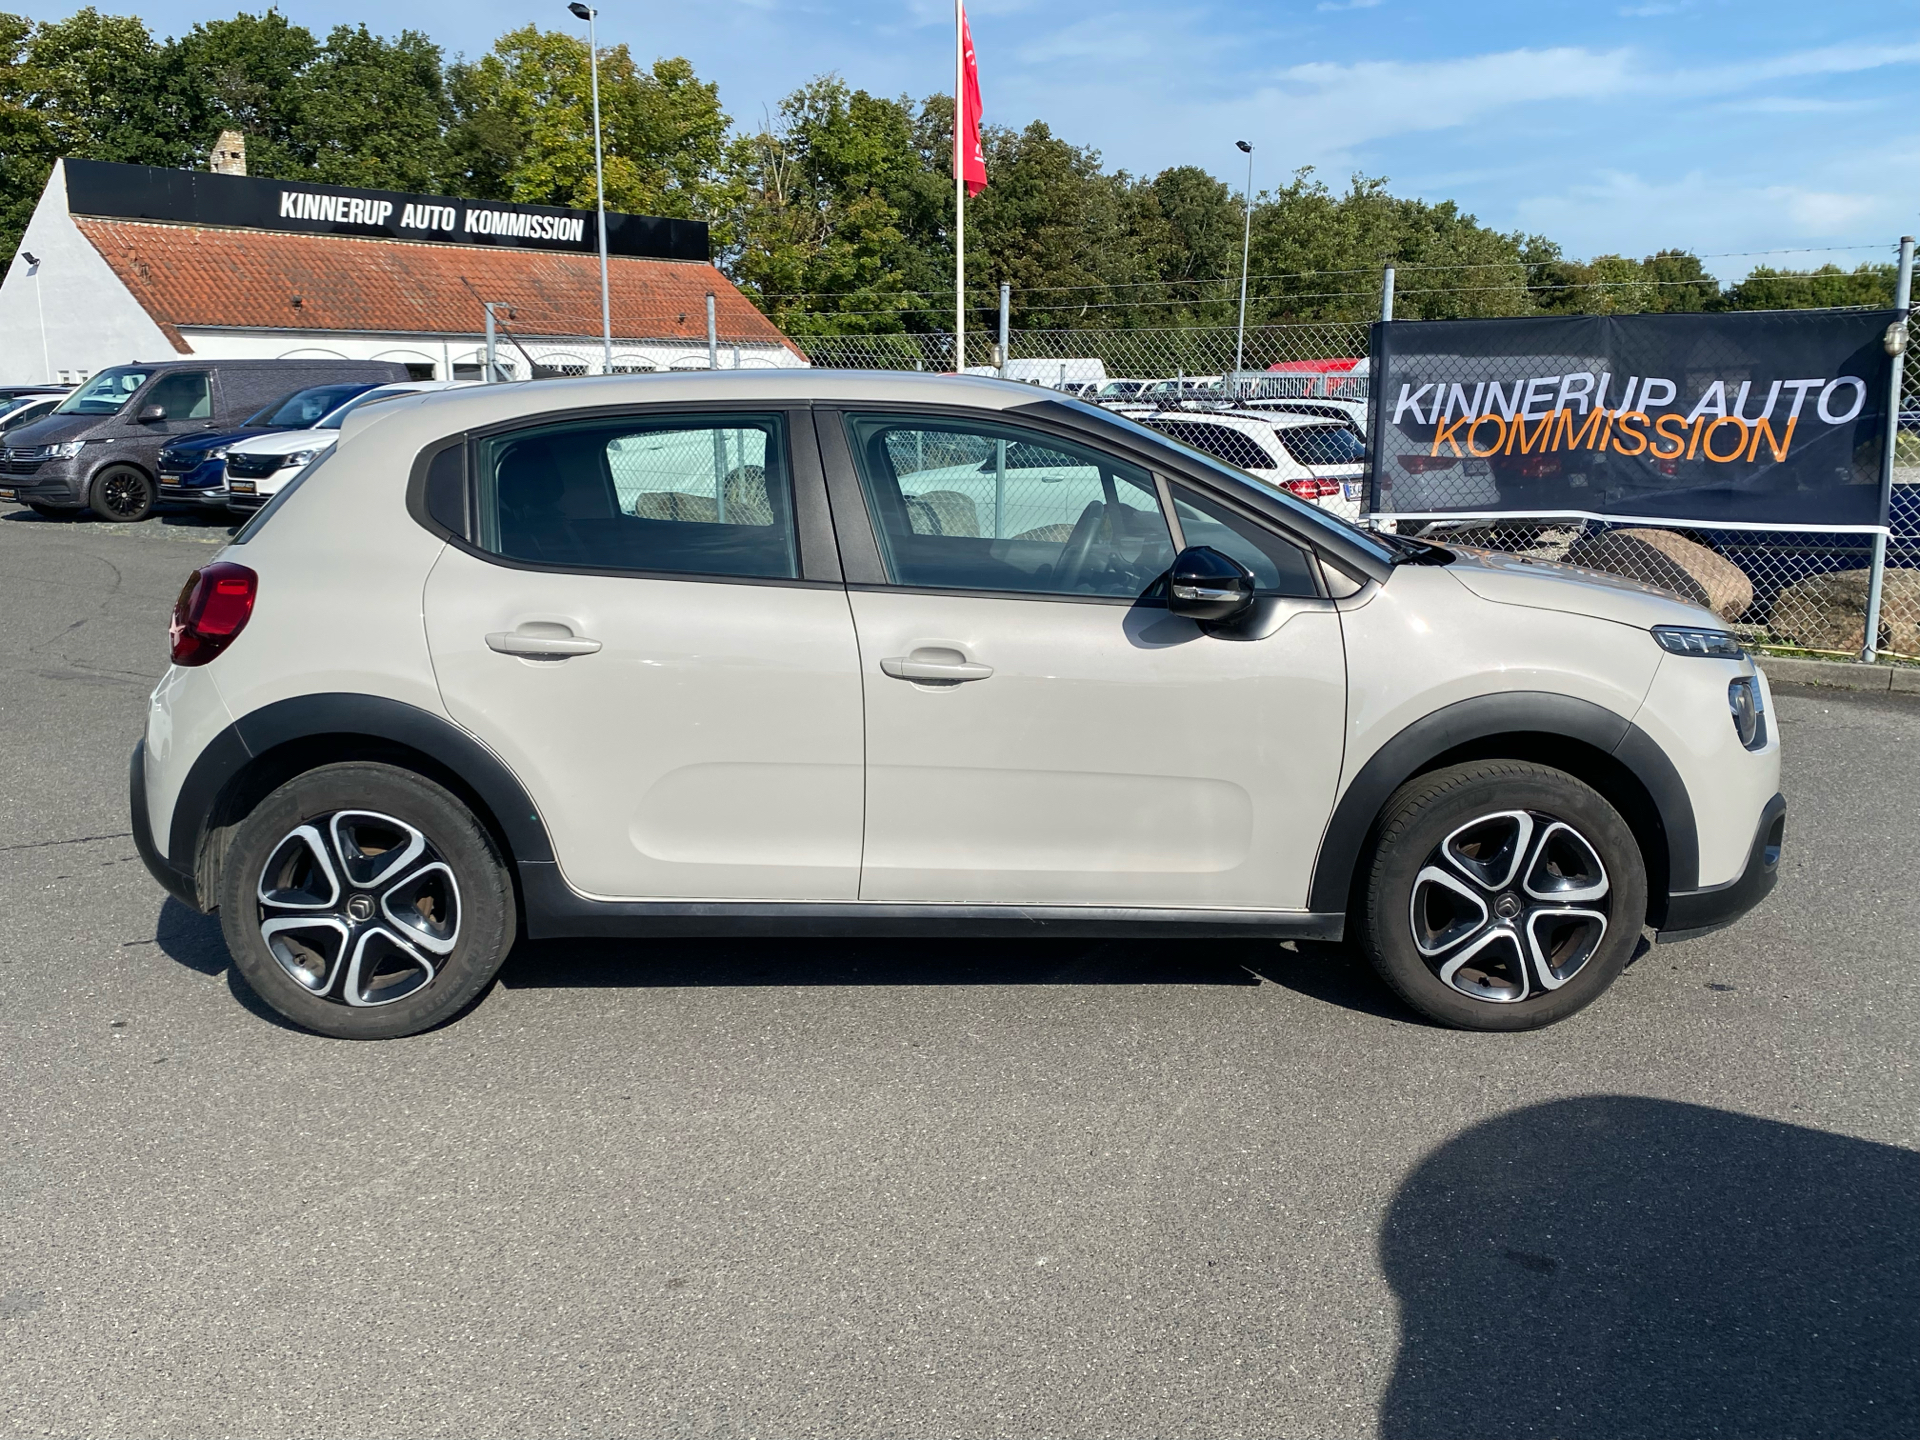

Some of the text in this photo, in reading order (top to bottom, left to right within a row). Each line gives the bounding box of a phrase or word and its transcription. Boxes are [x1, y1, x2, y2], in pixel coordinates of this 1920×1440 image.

[279, 191, 584, 242] KINNERUP AUTO KOMMISSION
[1392, 371, 1867, 427] KINNERUP AUTO
[1430, 407, 1796, 463] KOMMISSION
